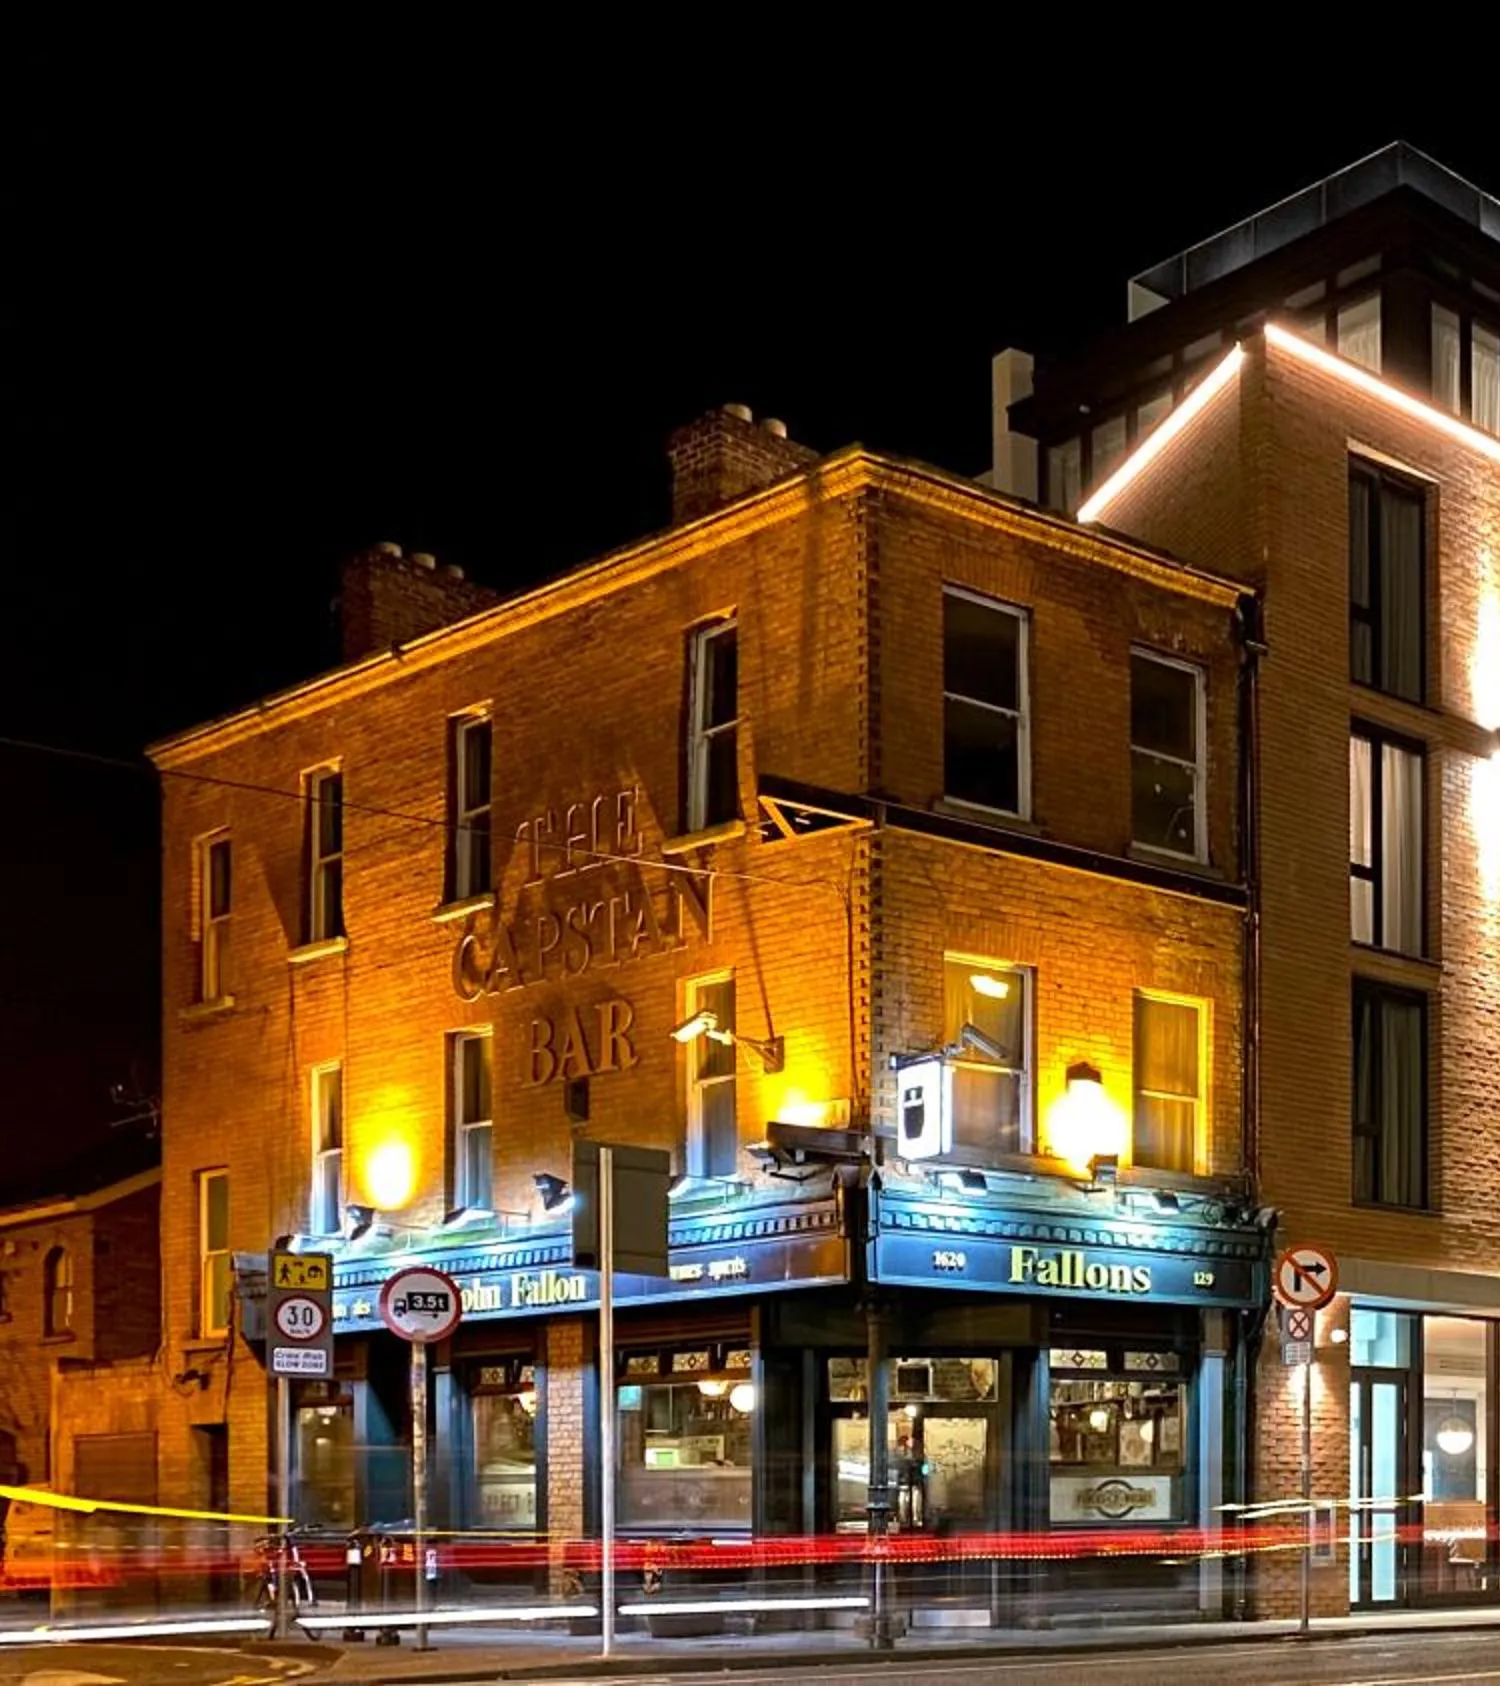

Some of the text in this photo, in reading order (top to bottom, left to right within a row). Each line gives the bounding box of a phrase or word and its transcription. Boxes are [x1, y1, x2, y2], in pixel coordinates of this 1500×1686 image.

[514, 783, 644, 889] THE
[451, 868, 716, 1003] CAPSTAN
[519, 998, 639, 1089] BAR
[455, 1270, 587, 1312] ohn Fallon
[1007, 1246, 1152, 1293] Fallons
[286, 1305, 314, 1327] 30
[412, 1294, 446, 1310] 3.5t
